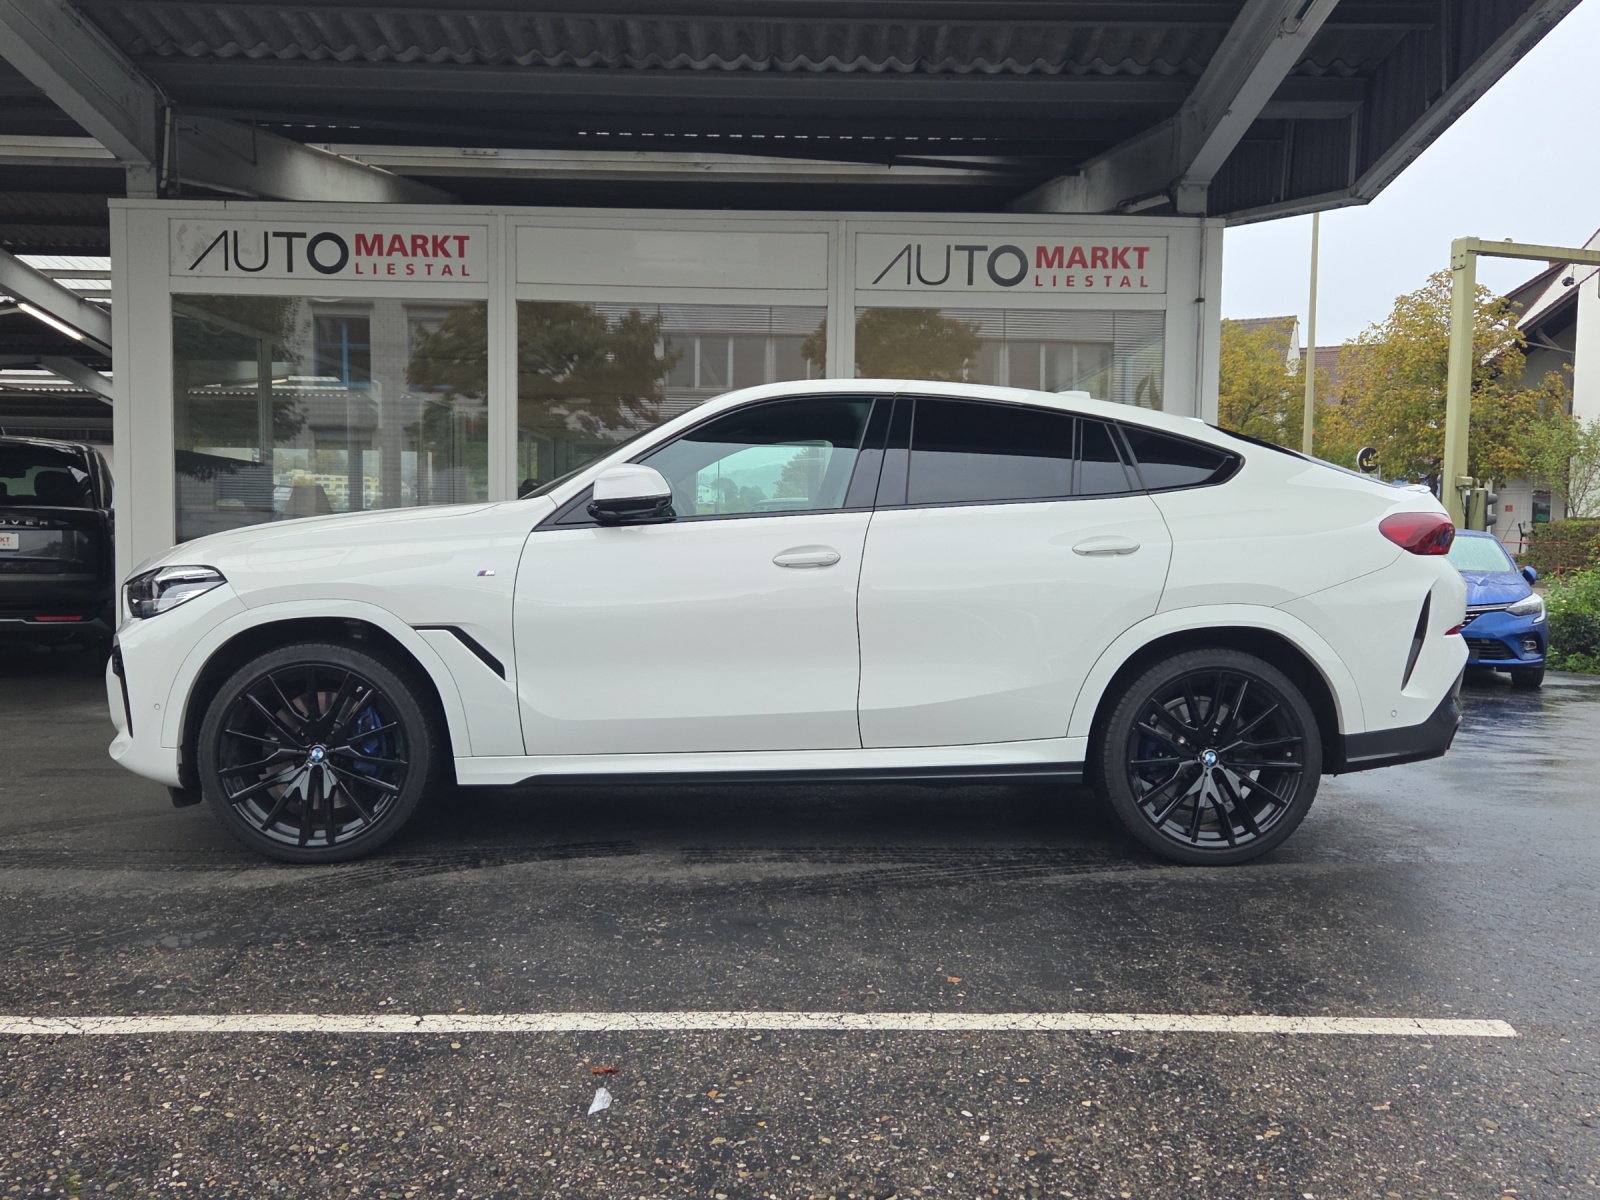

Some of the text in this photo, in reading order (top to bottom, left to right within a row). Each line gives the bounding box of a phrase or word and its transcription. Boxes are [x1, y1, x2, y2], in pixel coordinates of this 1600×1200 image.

[188, 229, 471, 275] AUTO MARKT
[871, 243, 1150, 288] AUTO MARKT
[355, 262, 471, 277] LIESTAL
[1035, 274, 1149, 288] LIESTAL
